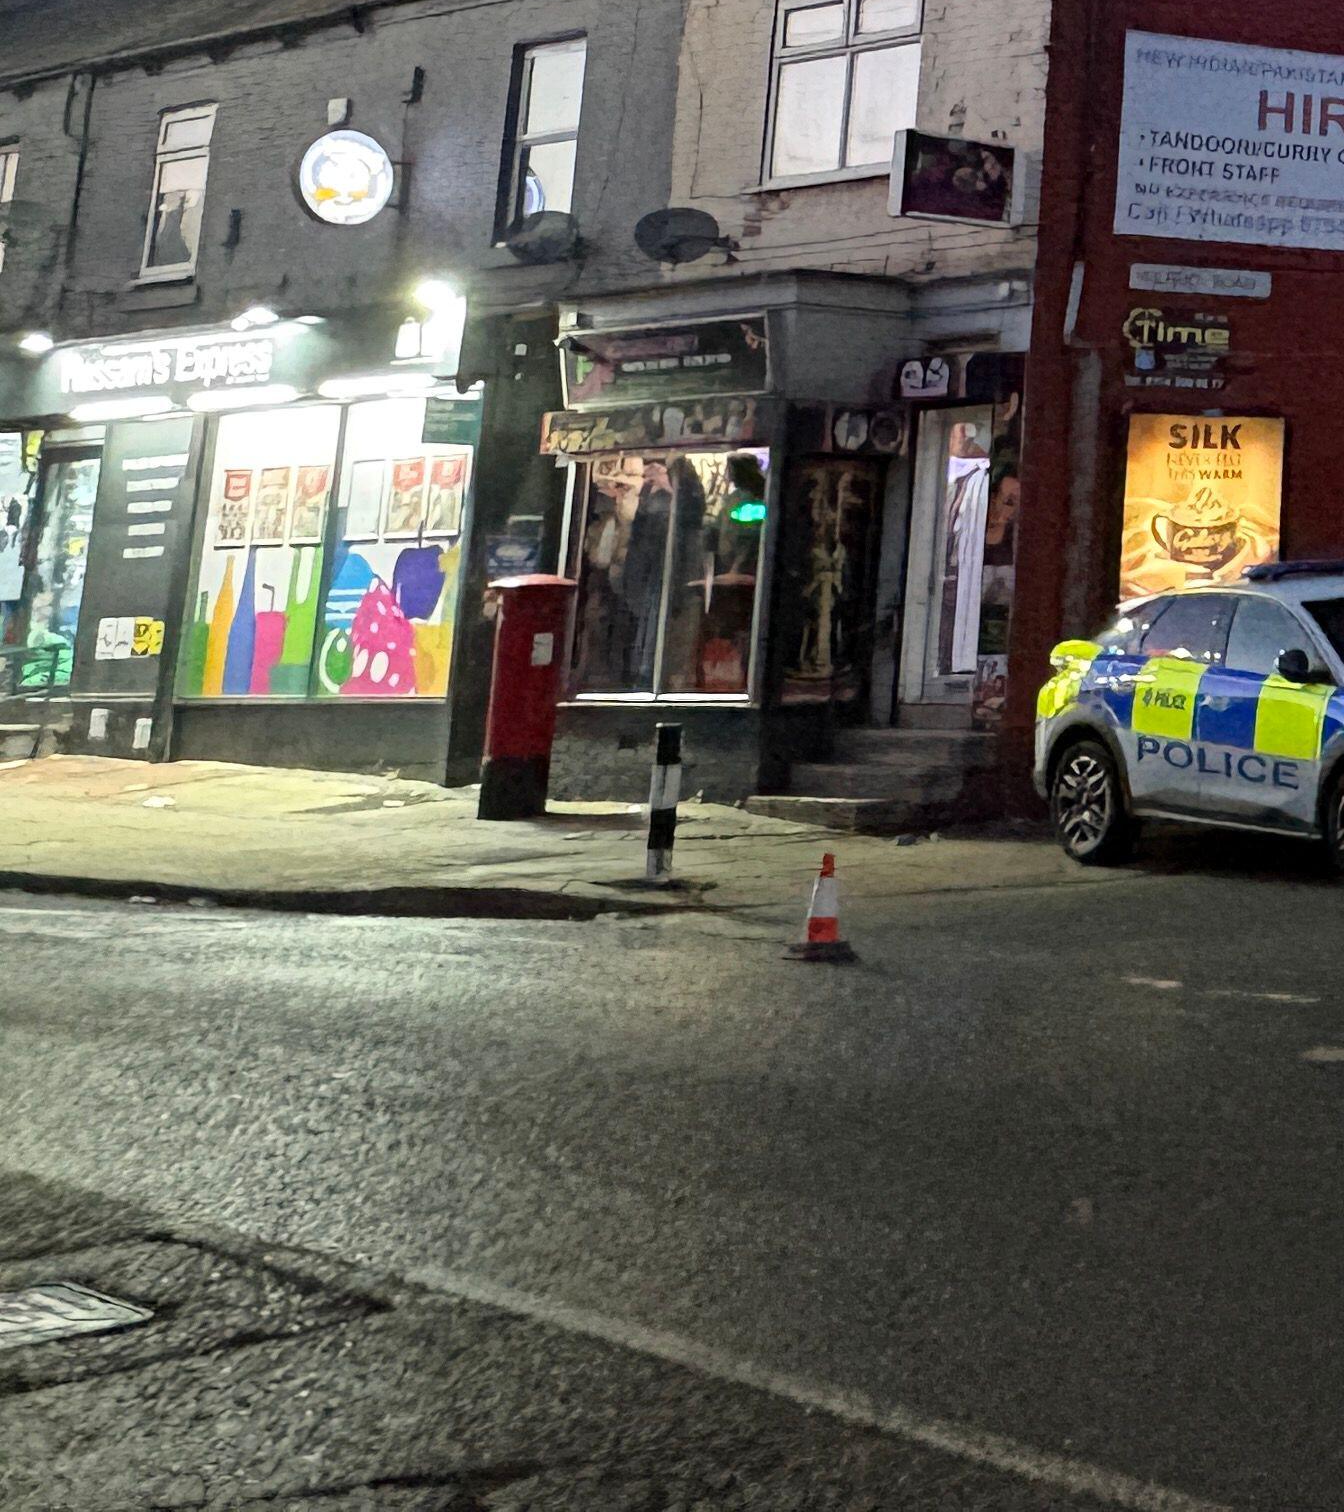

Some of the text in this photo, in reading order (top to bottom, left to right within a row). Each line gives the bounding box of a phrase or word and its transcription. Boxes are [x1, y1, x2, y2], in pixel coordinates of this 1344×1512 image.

[1149, 156, 1280, 184] FRONT STAFF
[1168, 423, 1242, 450] SILK
[1137, 737, 1299, 790] POLICE
